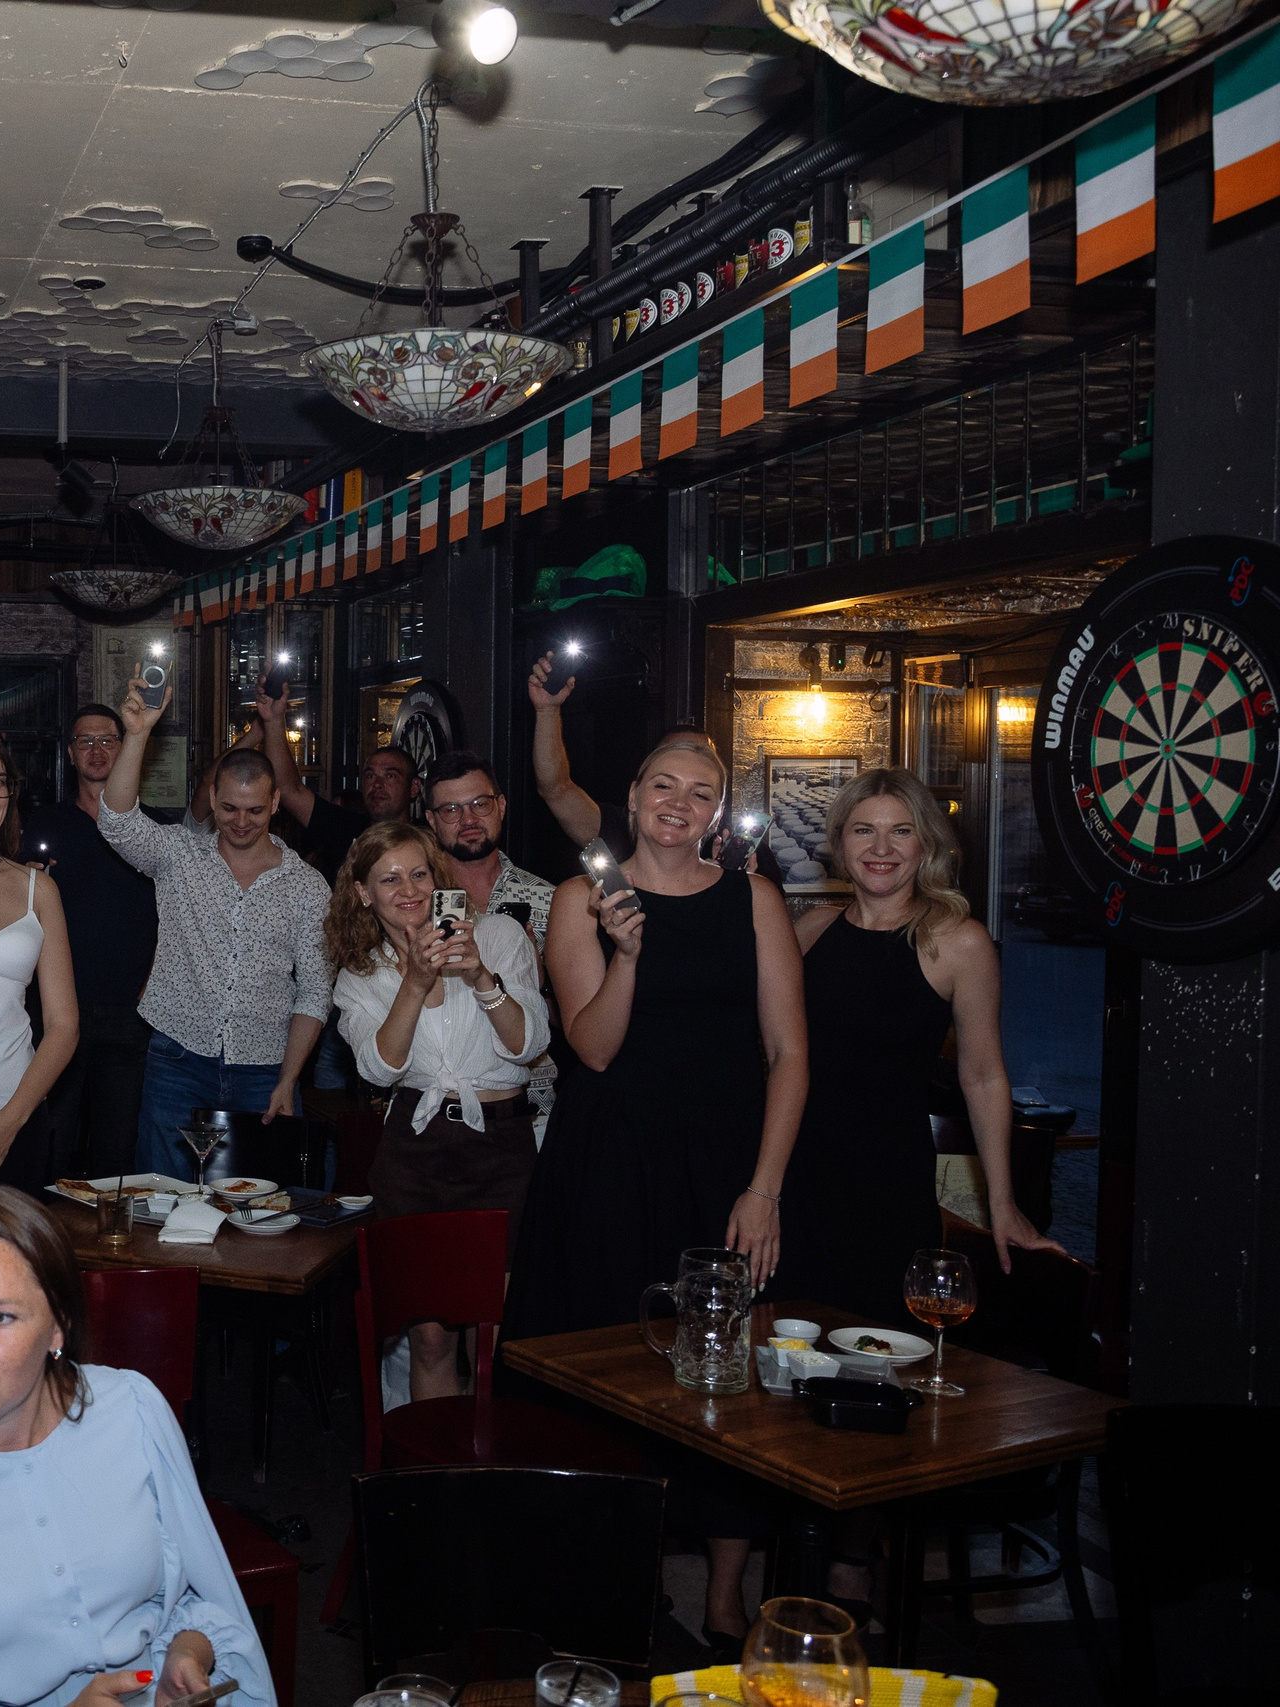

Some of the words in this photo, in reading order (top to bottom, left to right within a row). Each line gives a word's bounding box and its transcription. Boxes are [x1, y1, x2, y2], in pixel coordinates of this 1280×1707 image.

[1229, 560, 1257, 603] PDC
[1162, 612, 1179, 629] 20
[1182, 618, 1265, 694] SNIPER
[1088, 807, 1113, 843] GREAT
[1106, 885, 1127, 921] PDC
